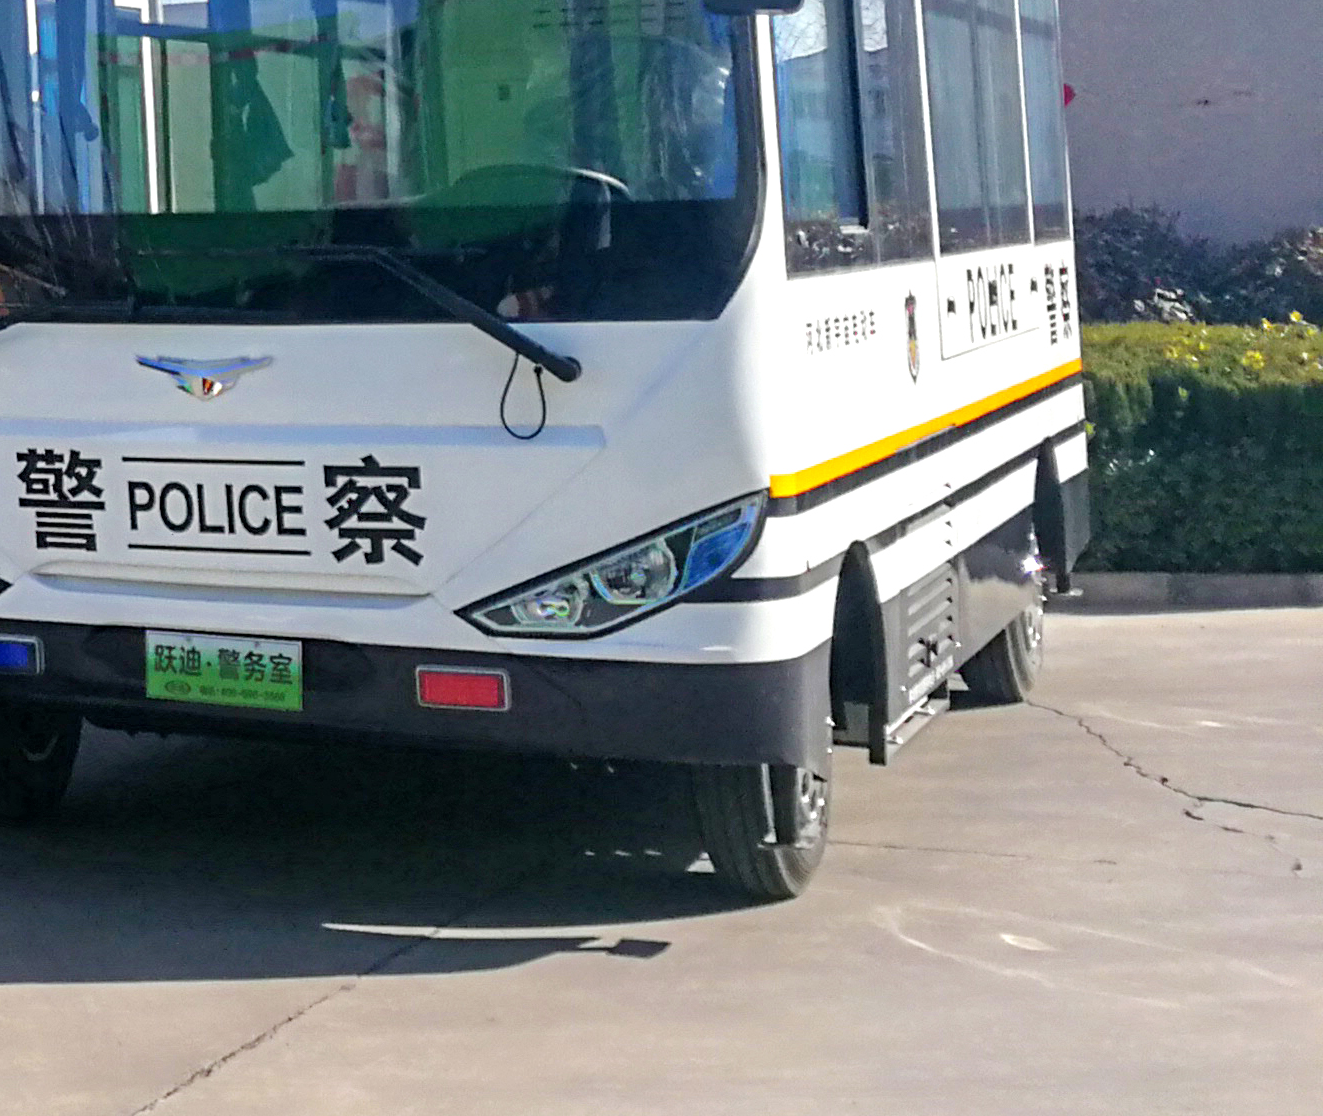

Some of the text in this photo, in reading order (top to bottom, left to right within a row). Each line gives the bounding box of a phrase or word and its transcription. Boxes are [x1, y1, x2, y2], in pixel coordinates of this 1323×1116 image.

[17, 448, 427, 566] 警 POLICE 察
